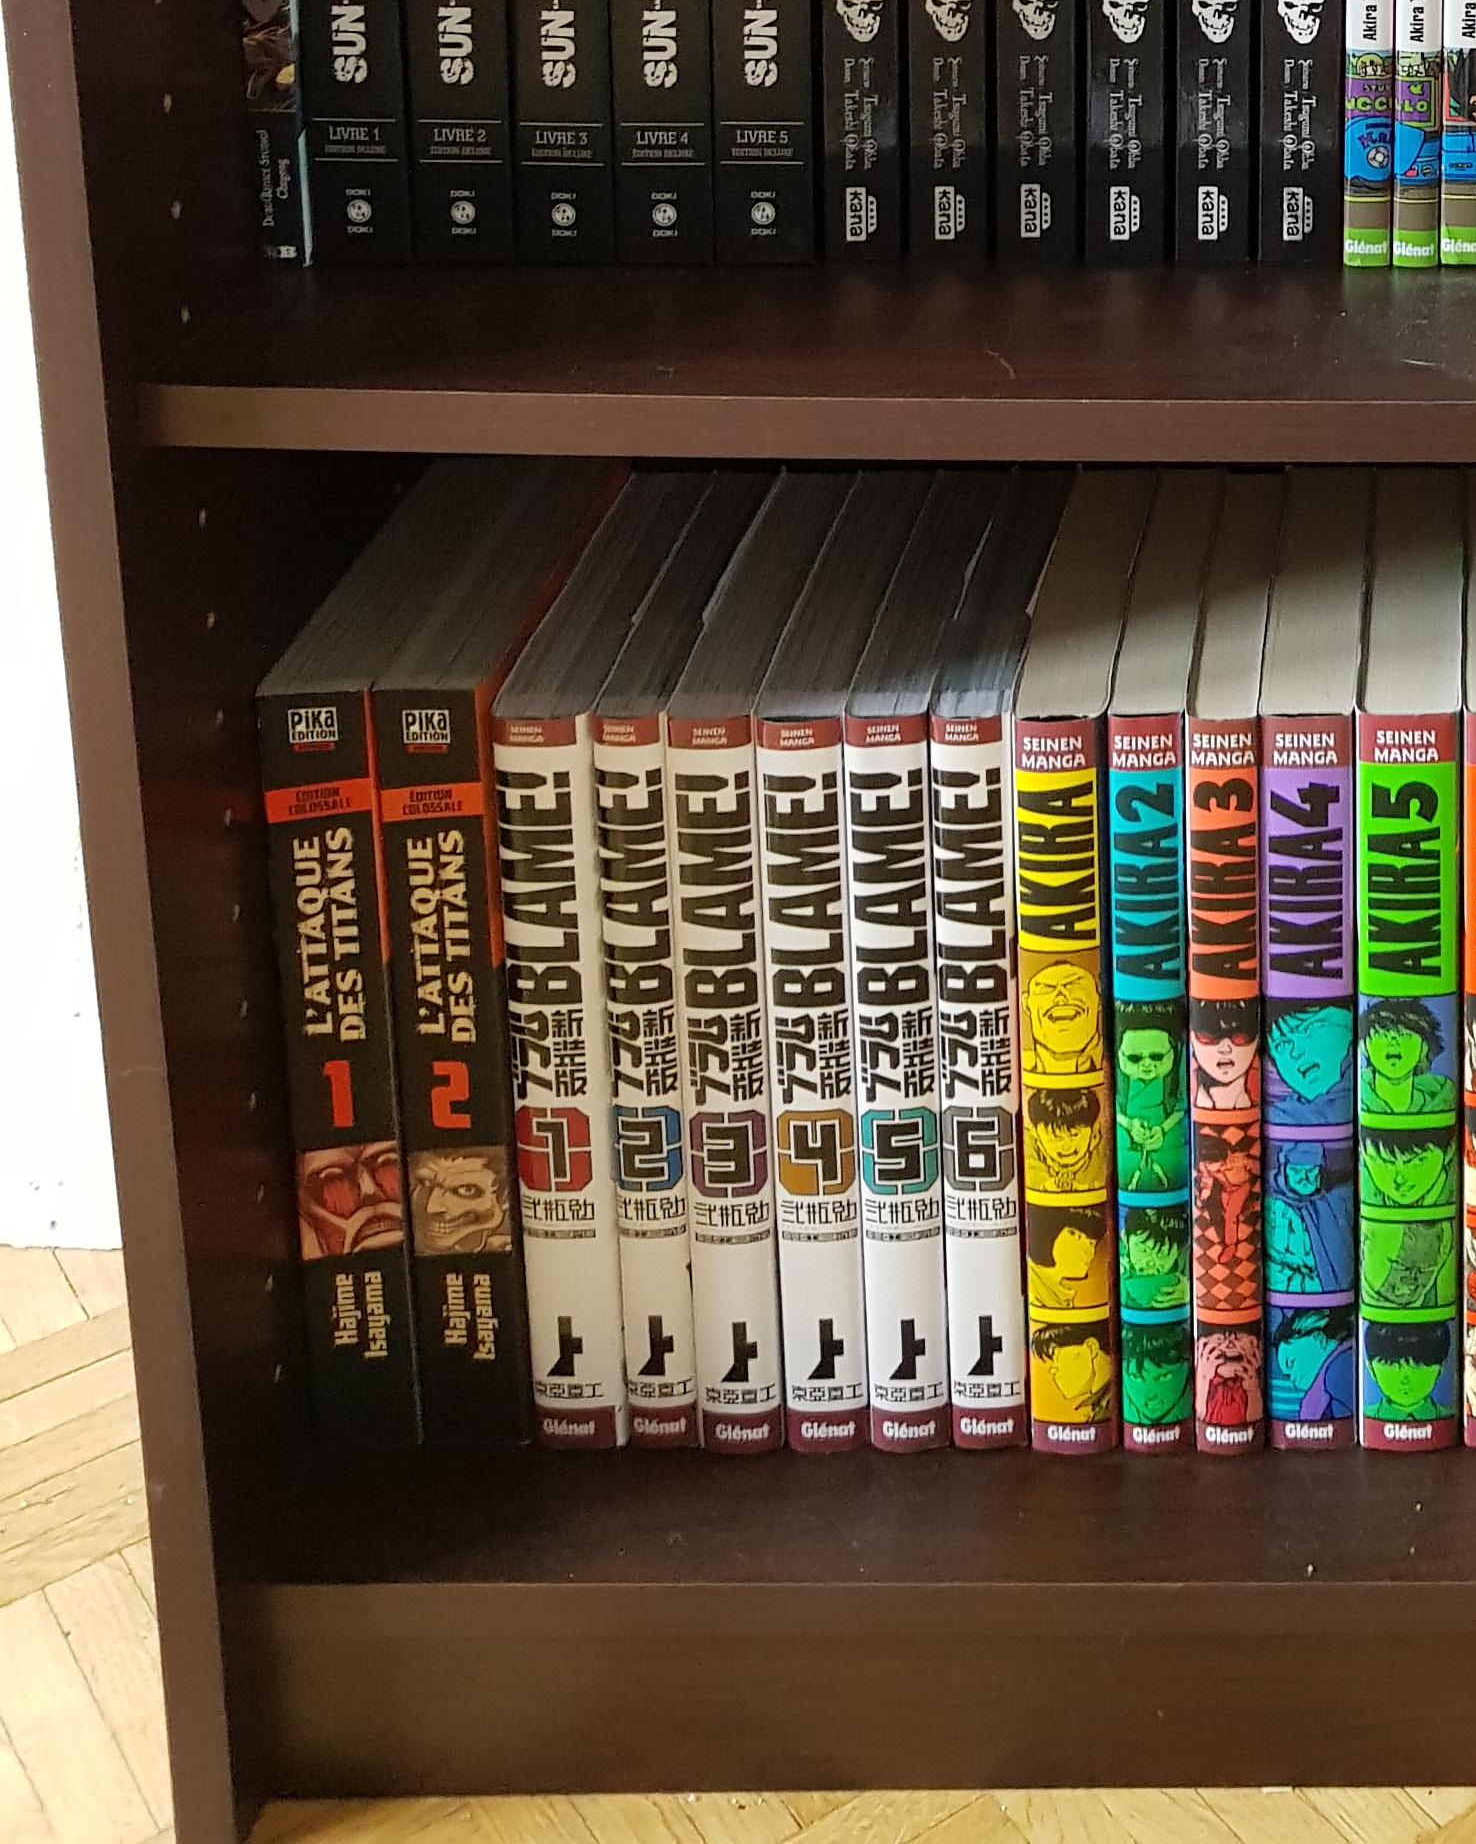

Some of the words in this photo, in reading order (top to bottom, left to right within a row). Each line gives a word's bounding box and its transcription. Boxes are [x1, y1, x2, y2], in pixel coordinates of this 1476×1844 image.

[1363, 5, 1377, 40] Akira
[330, 126, 369, 140] LIVRE
[374, 128, 379, 140] 1
[737, 130, 776, 143] LIVRE
[779, 131, 788, 143] 5
[850, 192, 863, 237] kana
[1113, 190, 1126, 236] kana
[1021, 751, 1087, 768] MANGA
[1022, 734, 1083, 751] SEINEN
[1117, 782, 1176, 823] 2
[1269, 780, 1342, 826] 4
[1371, 780, 1439, 821] 5
[762, 768, 848, 1008] BLAME!
[932, 767, 1015, 1007] BLAME!
[1017, 778, 1098, 943] AKIRA
[438, 828, 467, 962] TITANS
[1114, 825, 1181, 982] AKIRA
[1268, 828, 1344, 980] AKIRA
[1365, 826, 1442, 978] AKIRA
[407, 837, 446, 1036] L'ATTAQUE
[451, 969, 478, 1044] DES
[324, 1060, 352, 1128] 1
[431, 1061, 470, 1129] 2
[793, 1122, 839, 1182] 4
[957, 1120, 996, 1177] 6
[444, 1271, 468, 1348] Hajime
[473, 1269, 495, 1362] Isayama
[801, 1421, 856, 1439] Glénat
[1382, 1422, 1434, 1442] Glénat
